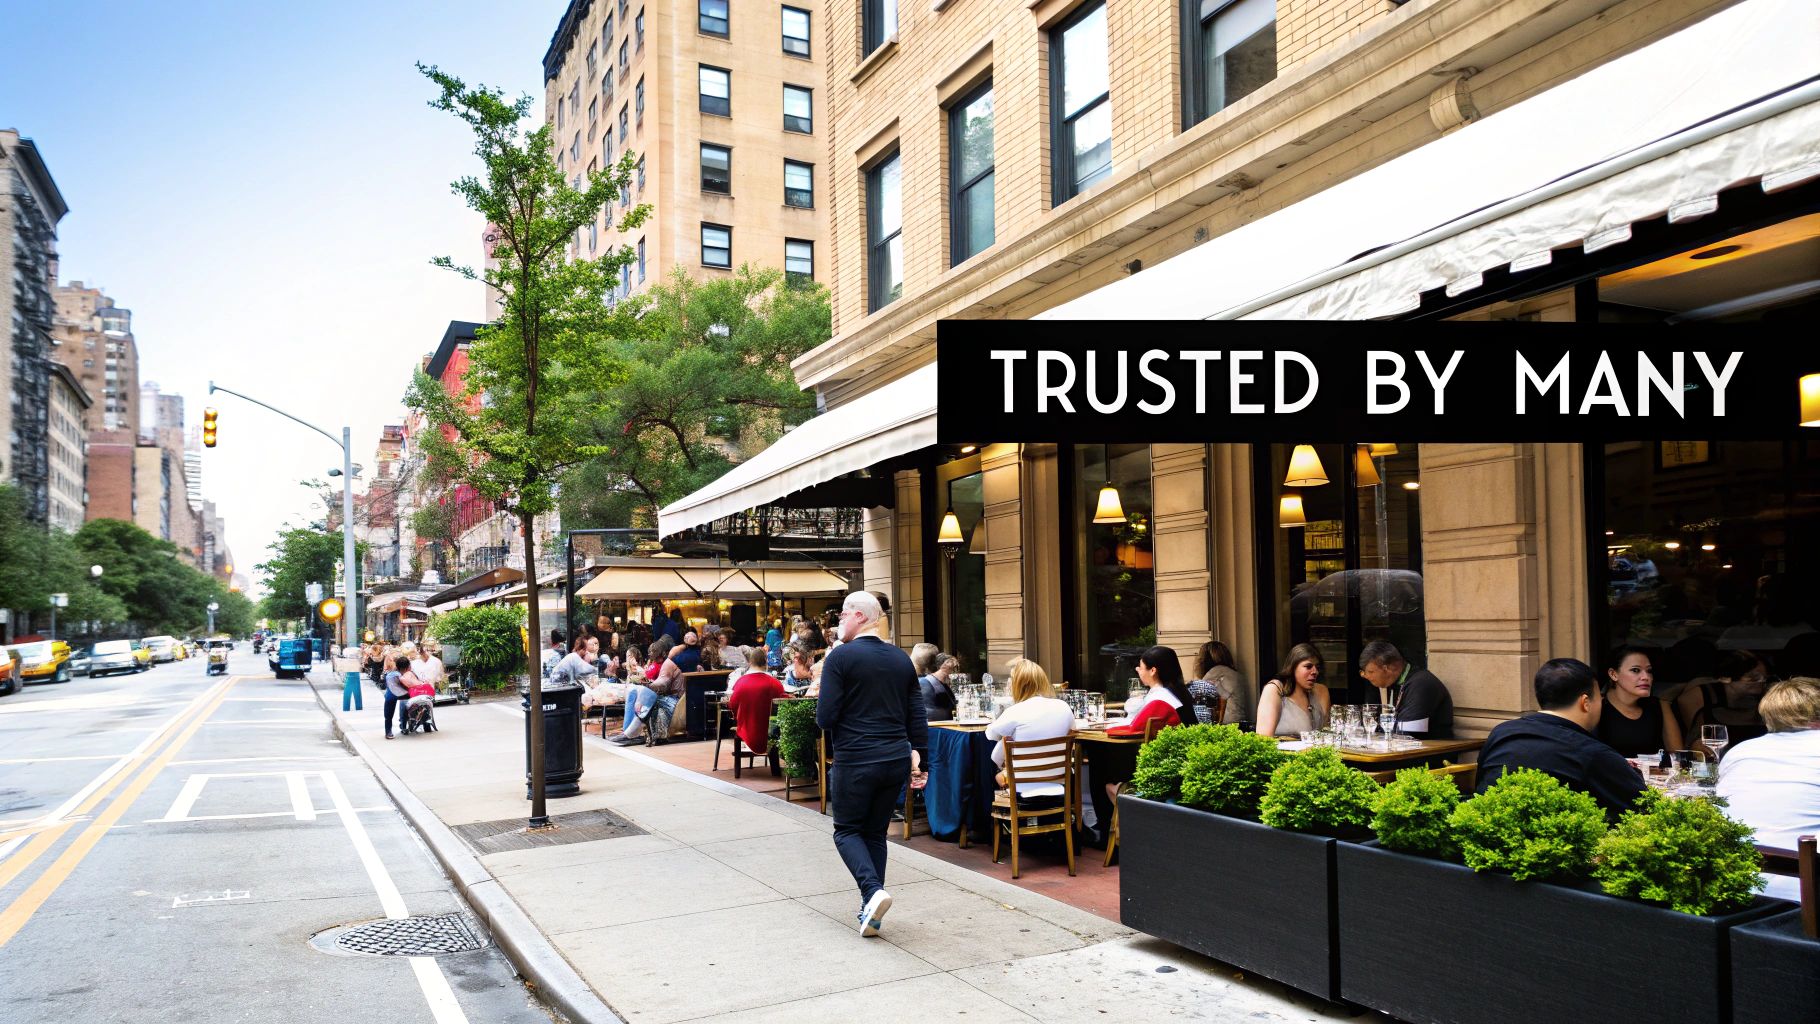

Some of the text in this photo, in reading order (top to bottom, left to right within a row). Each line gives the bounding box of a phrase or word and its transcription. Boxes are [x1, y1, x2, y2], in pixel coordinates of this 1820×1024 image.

[990, 349, 1744, 419] TRUSTED BY MANY
